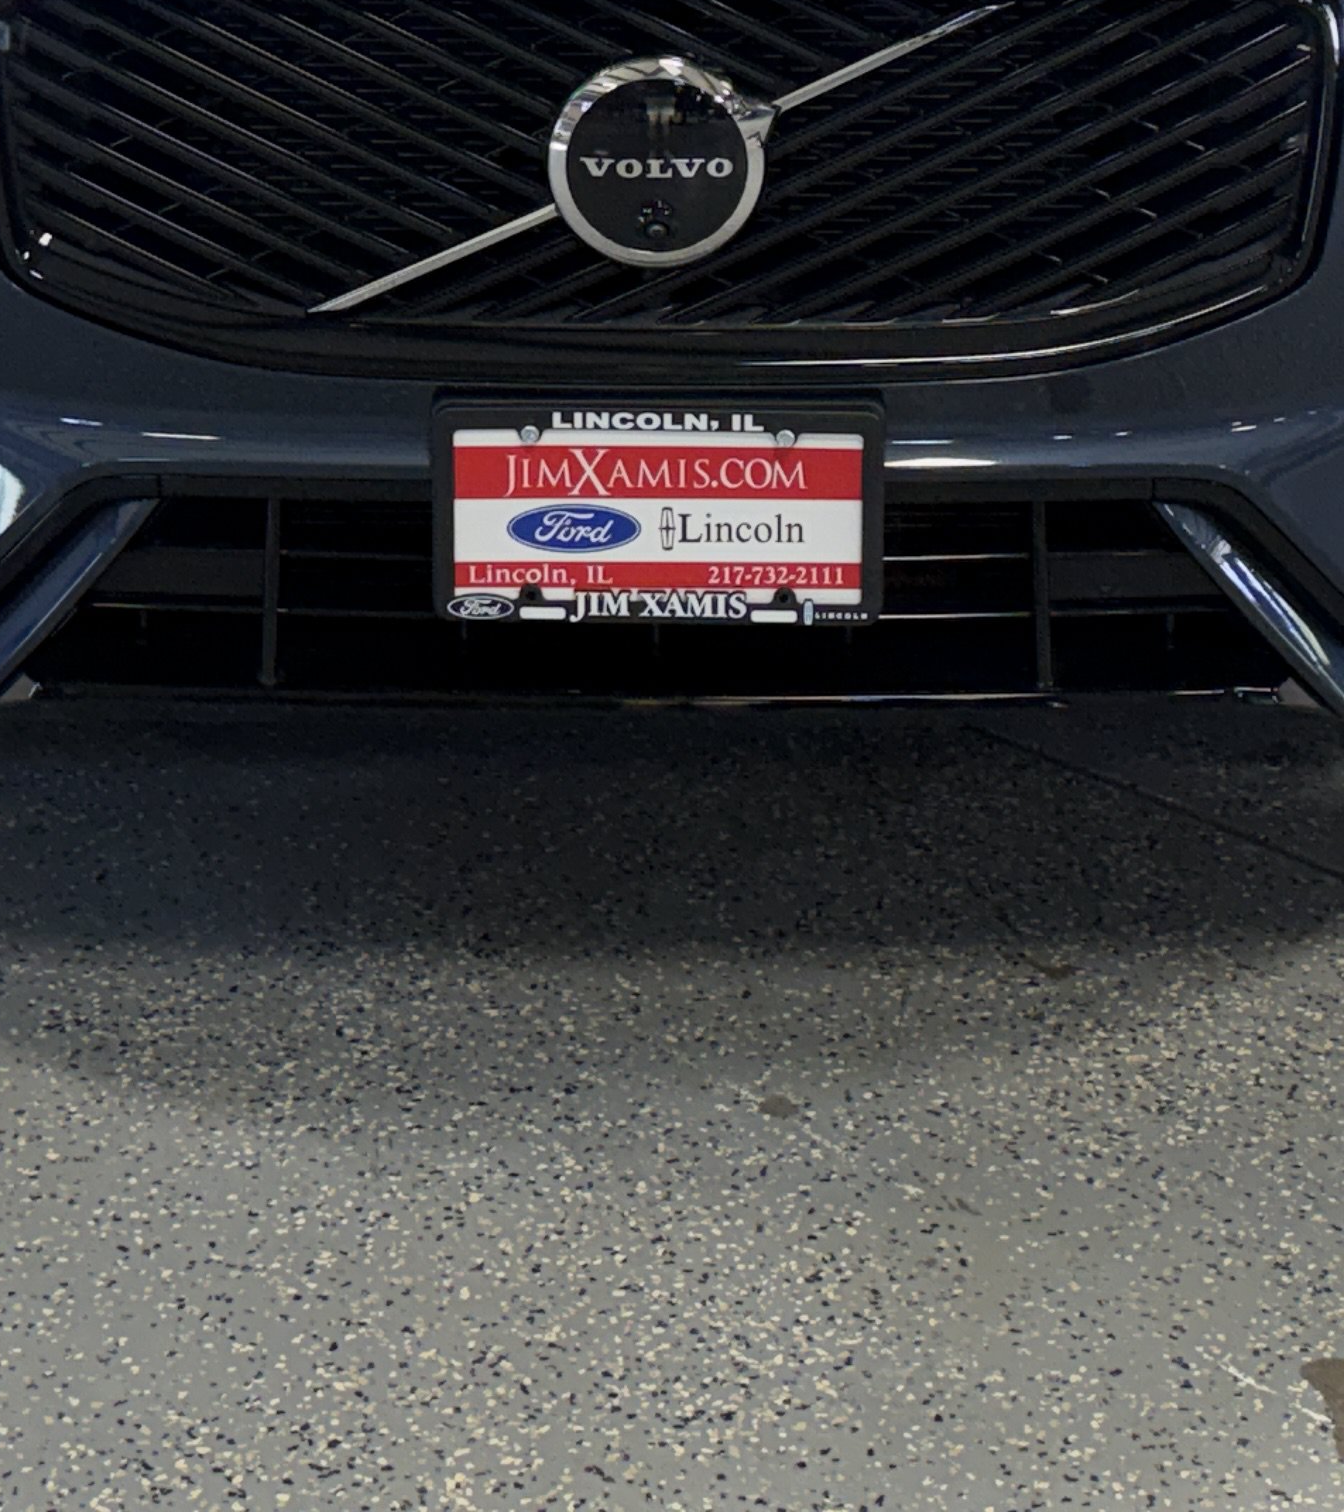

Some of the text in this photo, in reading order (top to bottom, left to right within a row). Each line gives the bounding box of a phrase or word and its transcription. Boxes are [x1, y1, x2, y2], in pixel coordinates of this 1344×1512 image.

[579, 157, 734, 179] VOLVO
[552, 411, 765, 432] LINCOLN, IL
[503, 448, 808, 497] JIMXAMIS.COM
[534, 510, 614, 543] Ford
[678, 513, 806, 543] Lincoln
[469, 563, 613, 586] Lincoln, IL
[708, 565, 844, 586] 217-732-2111
[460, 599, 502, 615] Ford
[569, 591, 748, 623] JIM XAMIS
